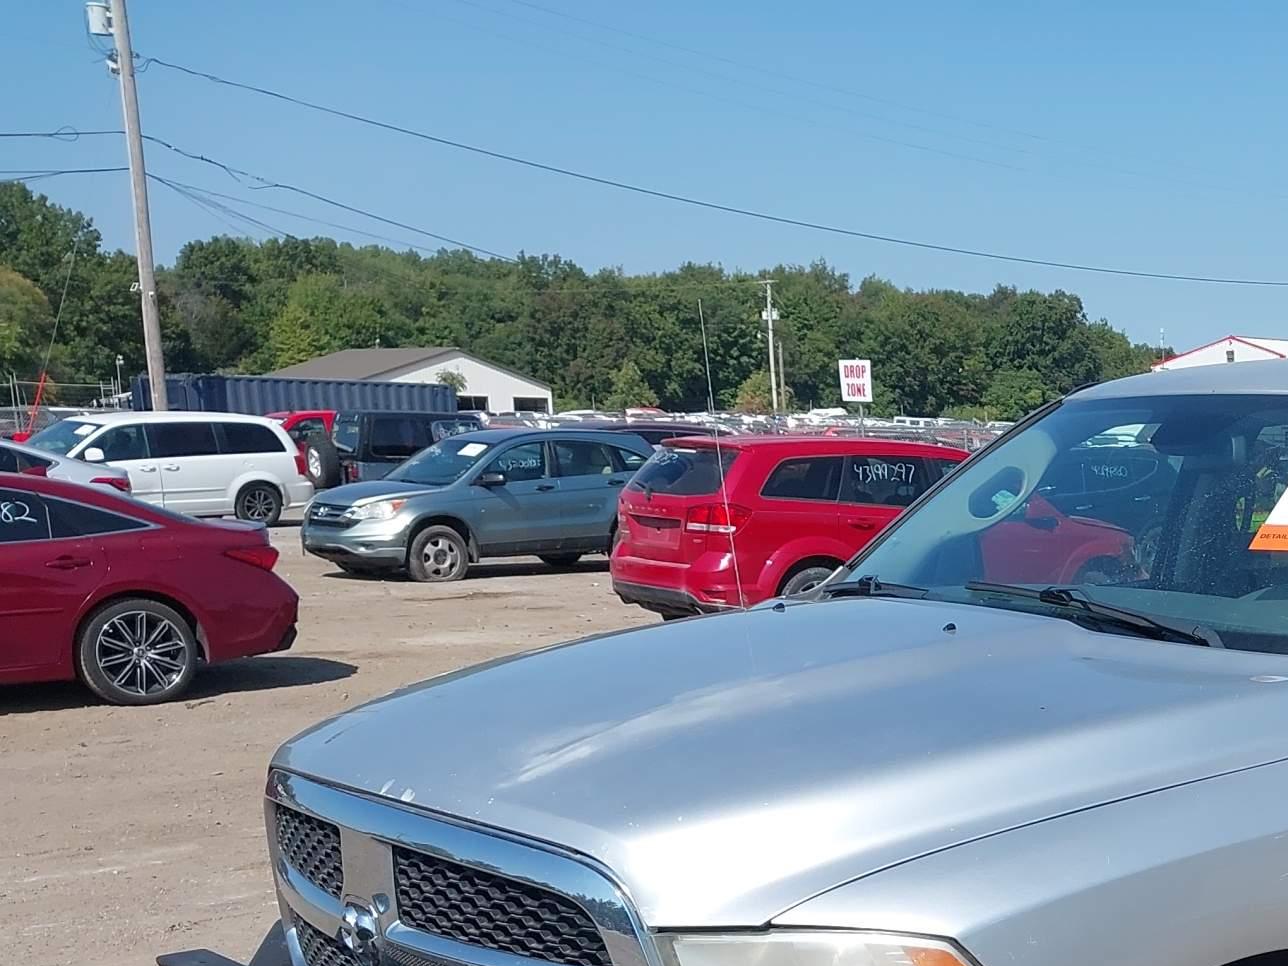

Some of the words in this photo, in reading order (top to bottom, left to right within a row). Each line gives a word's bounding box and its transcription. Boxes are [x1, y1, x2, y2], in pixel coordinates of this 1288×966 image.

[843, 365, 867, 379] DROP
[846, 383, 867, 397] ZONE
[853, 463, 915, 484] 43199297
